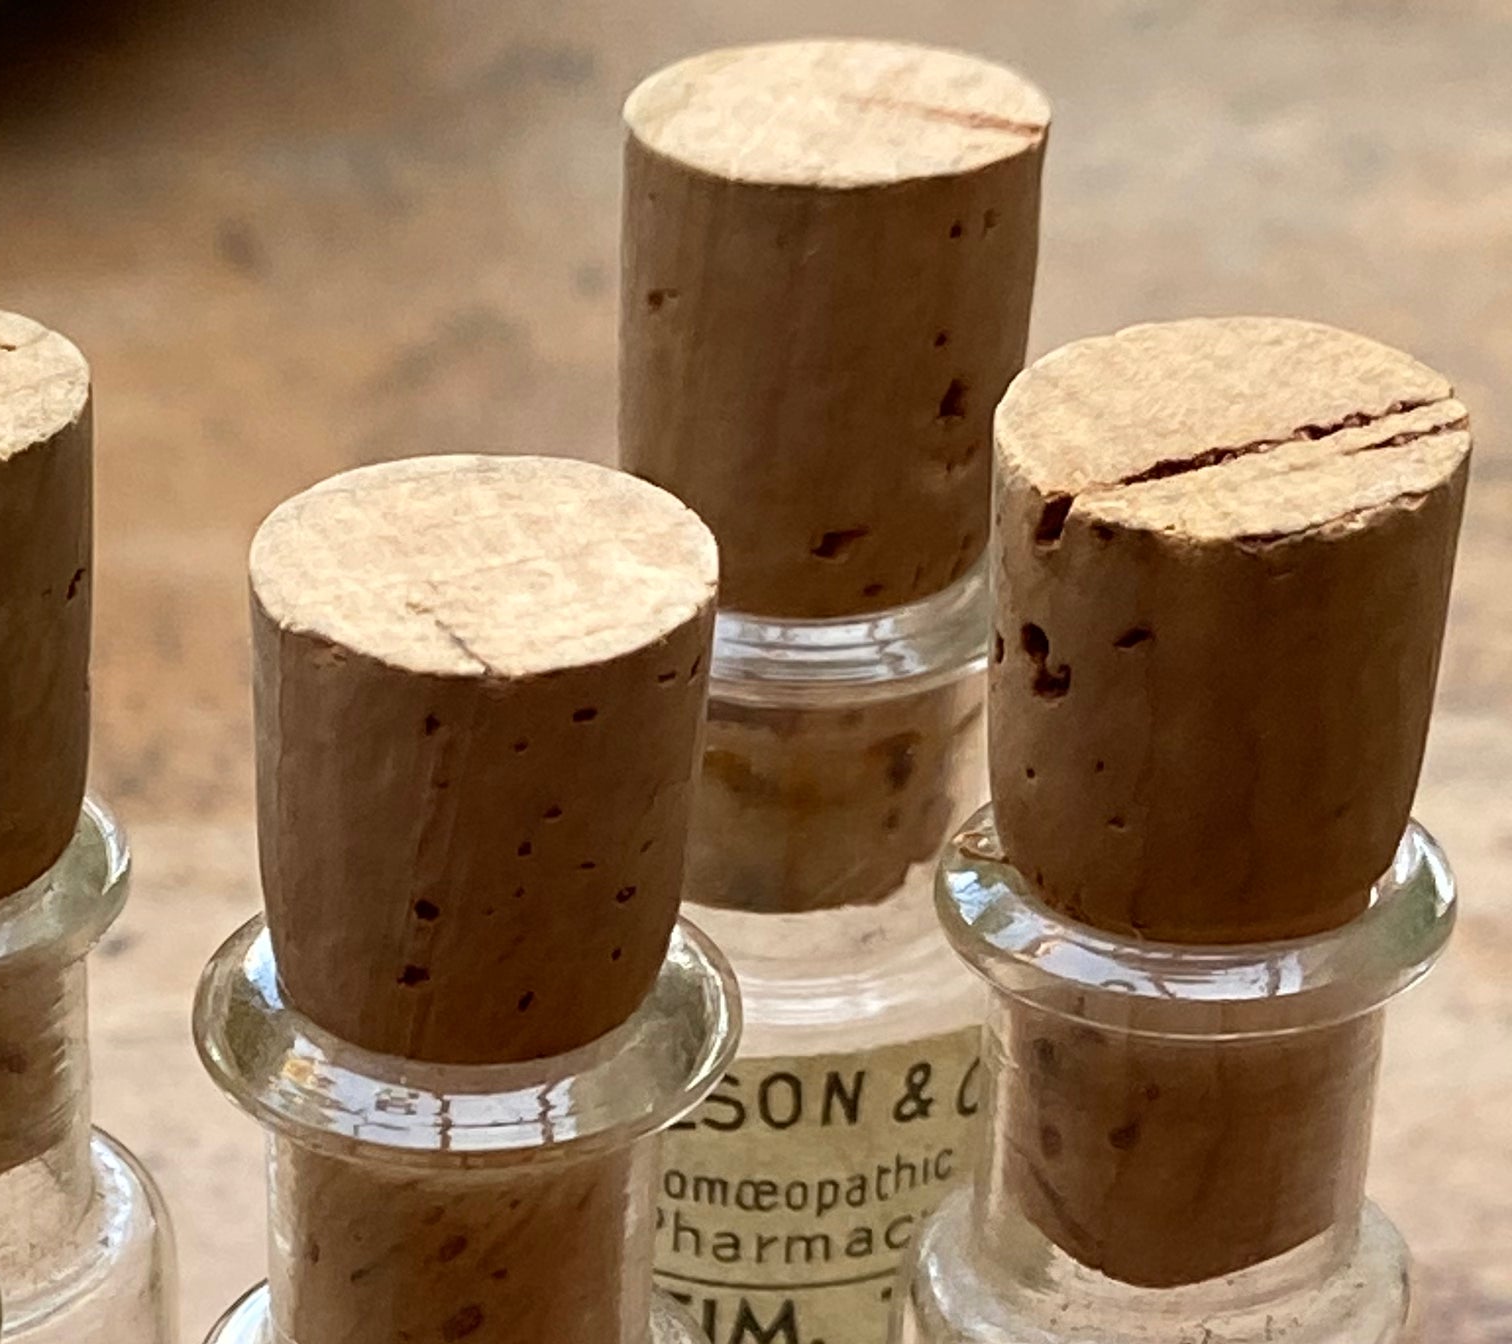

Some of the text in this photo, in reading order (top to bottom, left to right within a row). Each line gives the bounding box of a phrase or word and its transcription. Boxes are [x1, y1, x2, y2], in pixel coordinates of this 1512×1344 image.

[892, 1062, 935, 1124] &
[663, 1147, 954, 1218] omœopathic
[656, 1206, 918, 1264] harmac
